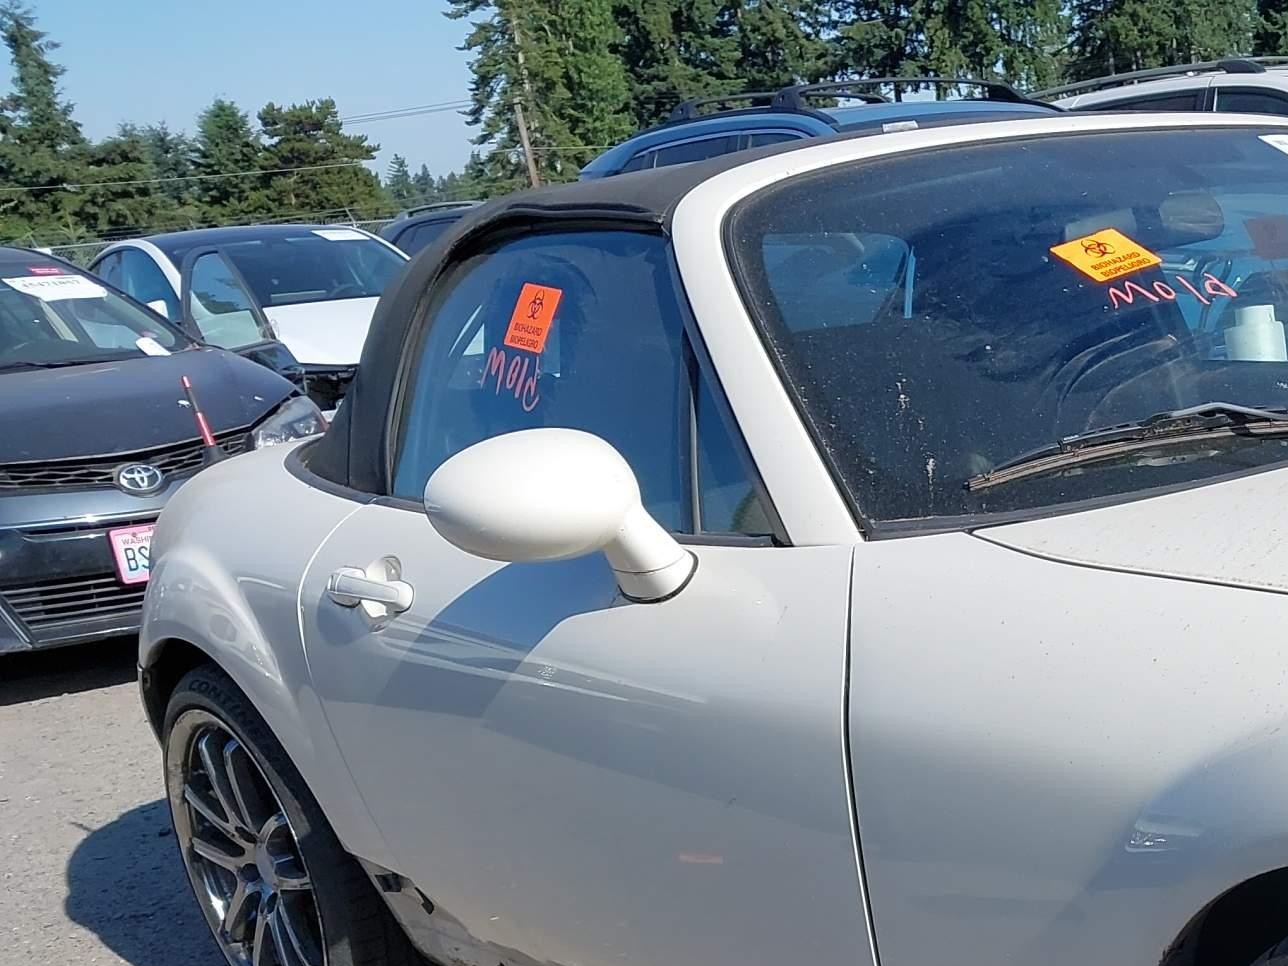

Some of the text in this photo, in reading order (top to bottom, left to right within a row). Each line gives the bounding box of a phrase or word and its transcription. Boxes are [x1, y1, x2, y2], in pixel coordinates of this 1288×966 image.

[1090, 251, 1141, 271] BIOHAZARD
[1100, 258, 1151, 278] BIOPELIGRO
[513, 322, 543, 337] BIOHAZARD
